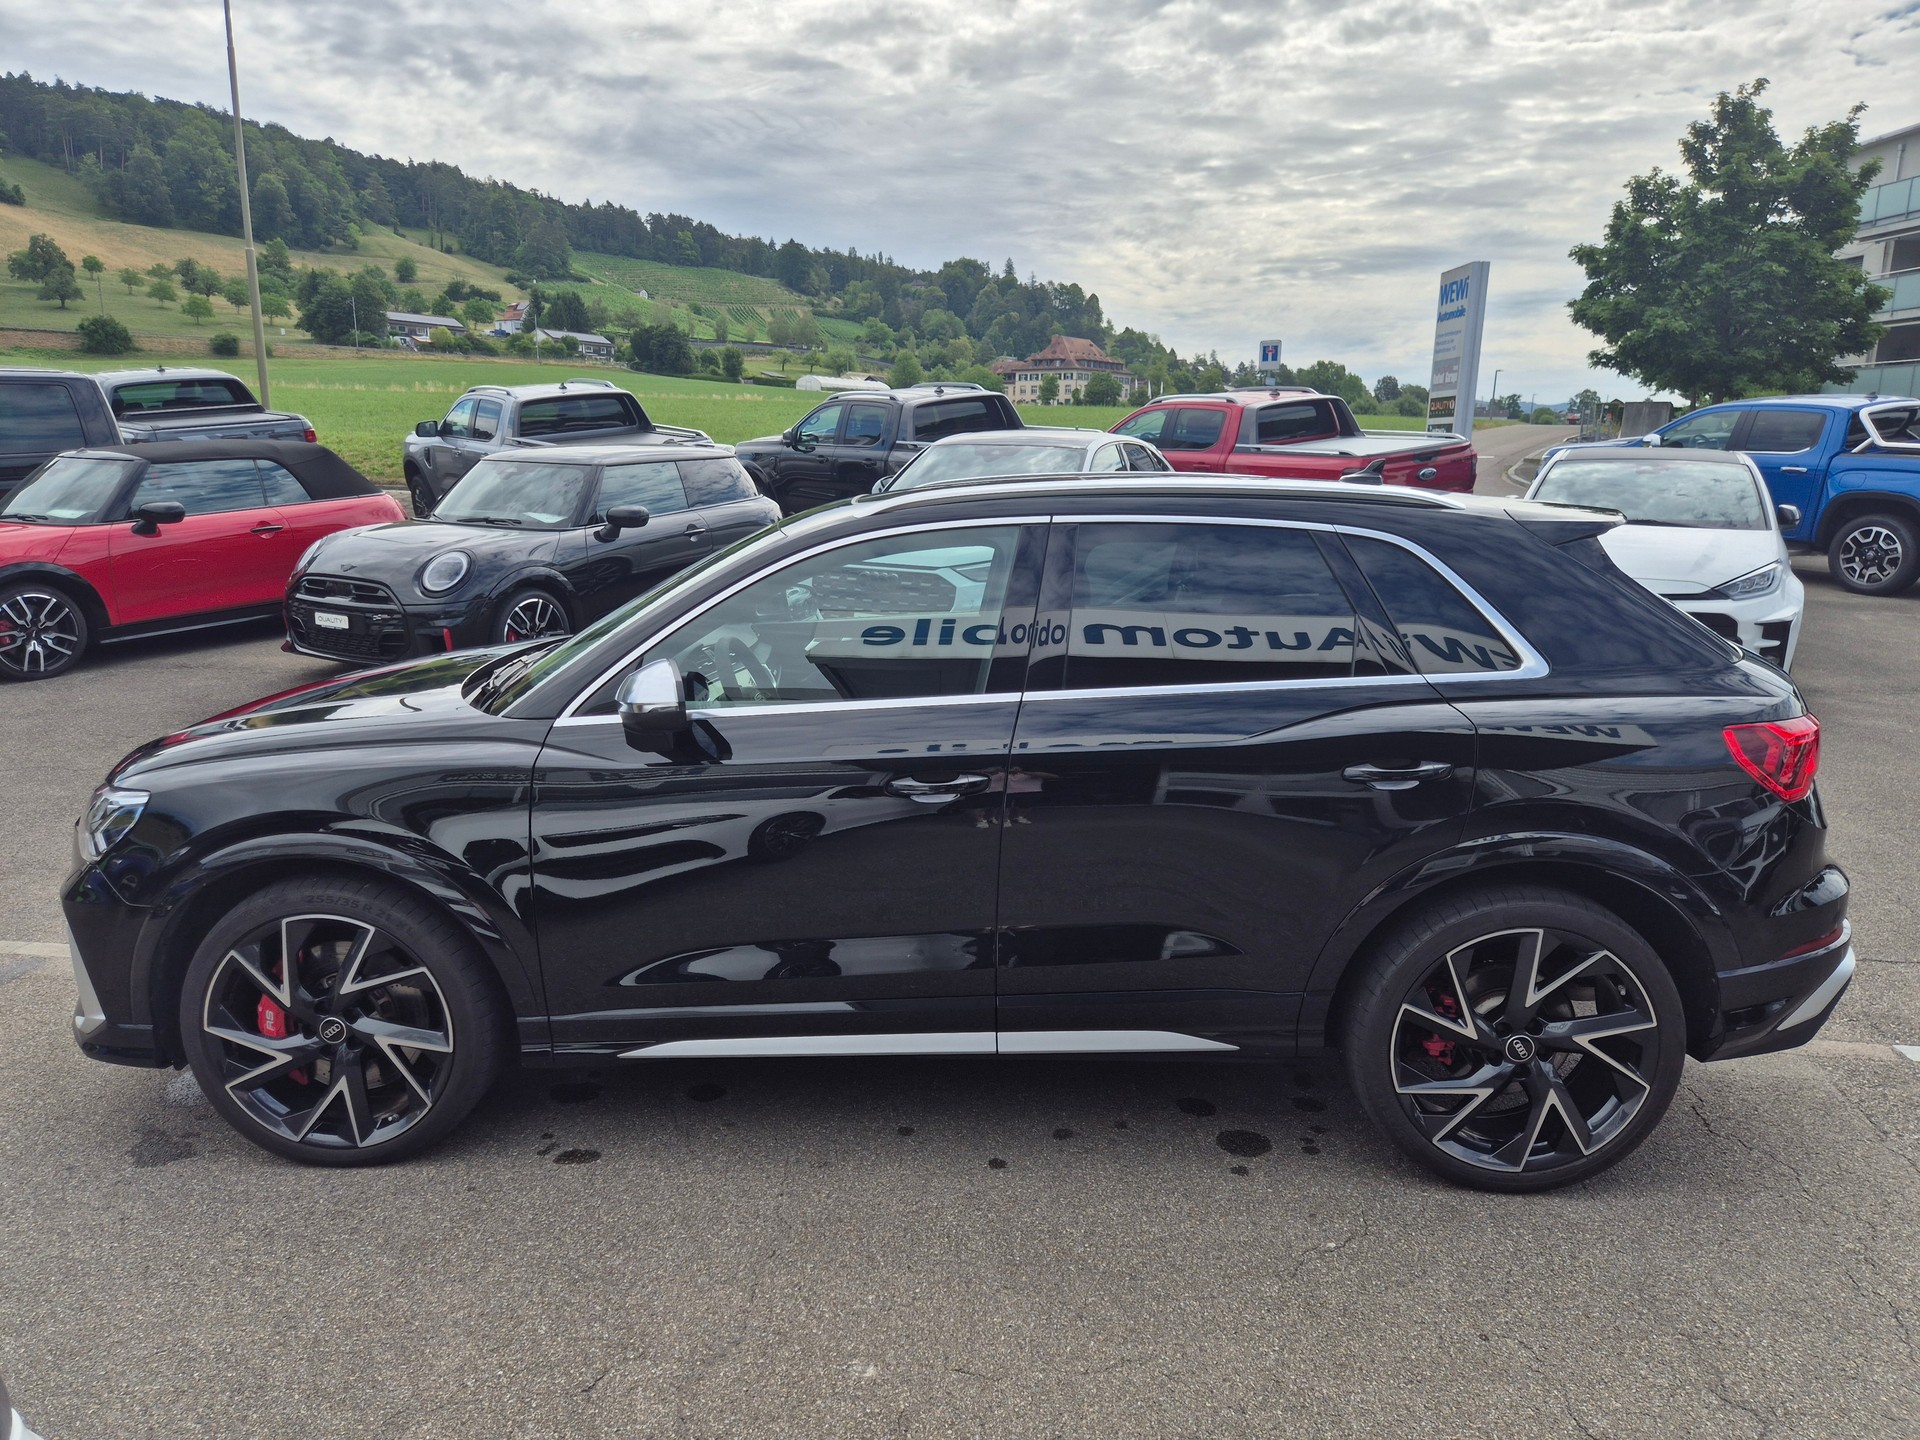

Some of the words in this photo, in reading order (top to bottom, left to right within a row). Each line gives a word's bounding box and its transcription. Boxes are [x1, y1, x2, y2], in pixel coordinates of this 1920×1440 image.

[1437, 305, 1466, 323] Automobile
[318, 615, 343, 624] QUALITY
[265, 1011, 274, 1031] RS
